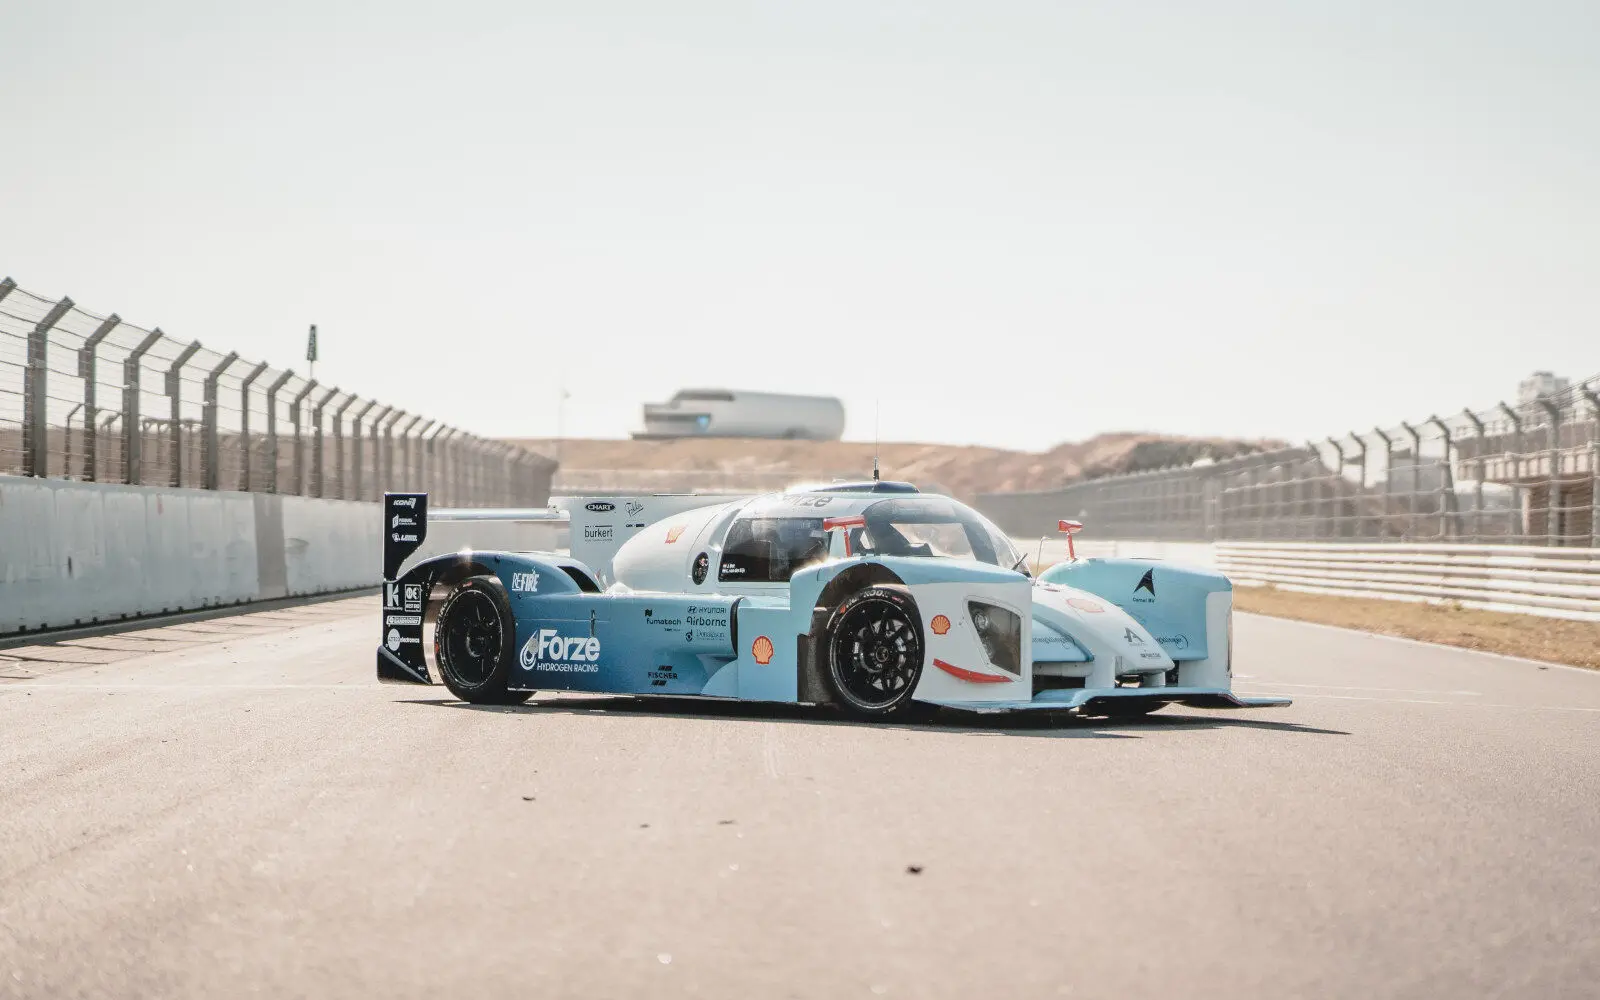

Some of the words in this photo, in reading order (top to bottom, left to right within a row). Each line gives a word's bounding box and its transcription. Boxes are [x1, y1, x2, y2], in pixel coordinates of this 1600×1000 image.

[686, 616, 727, 627] Airborne
[537, 629, 601, 662] Forze
[536, 662, 573, 672] HYDROGEN
[573, 663, 600, 673] RACING
[647, 671, 679, 680] FISCHER
